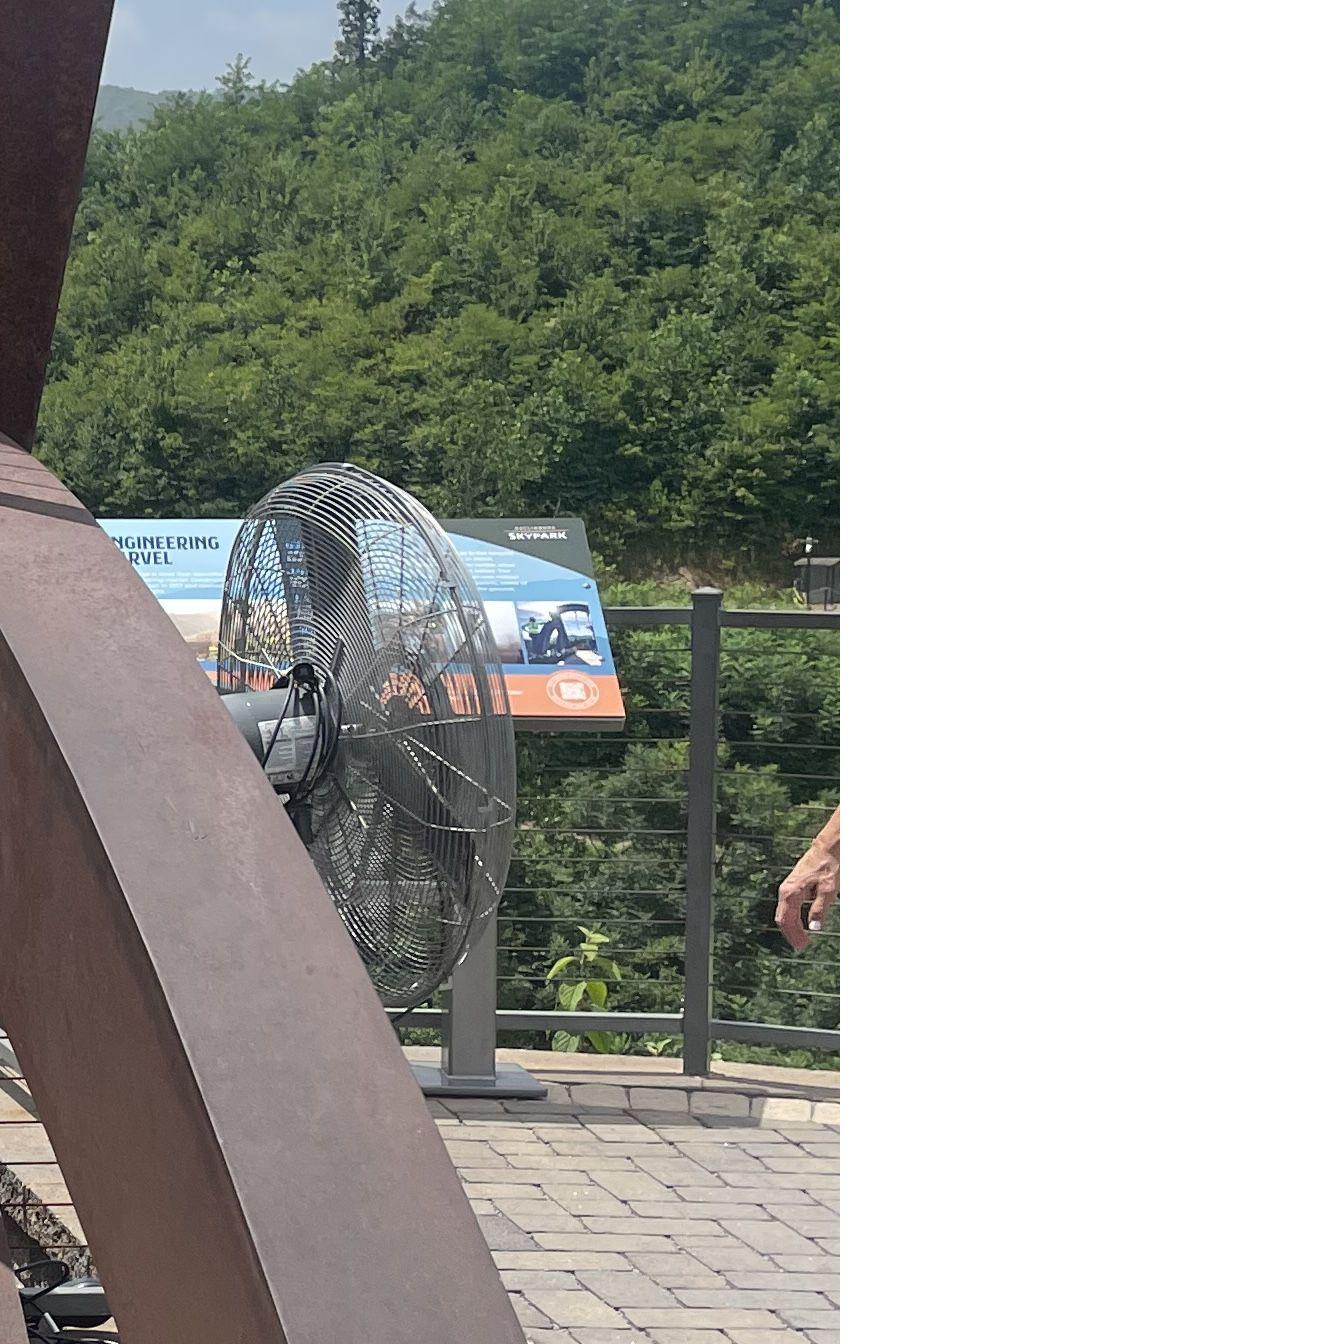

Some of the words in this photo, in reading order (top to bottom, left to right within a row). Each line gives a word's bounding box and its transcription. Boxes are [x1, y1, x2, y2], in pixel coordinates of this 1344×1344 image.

[112, 536, 220, 550] NGINEERING
[508, 531, 568, 541] SKYPARK
[123, 551, 173, 565] RVEL
